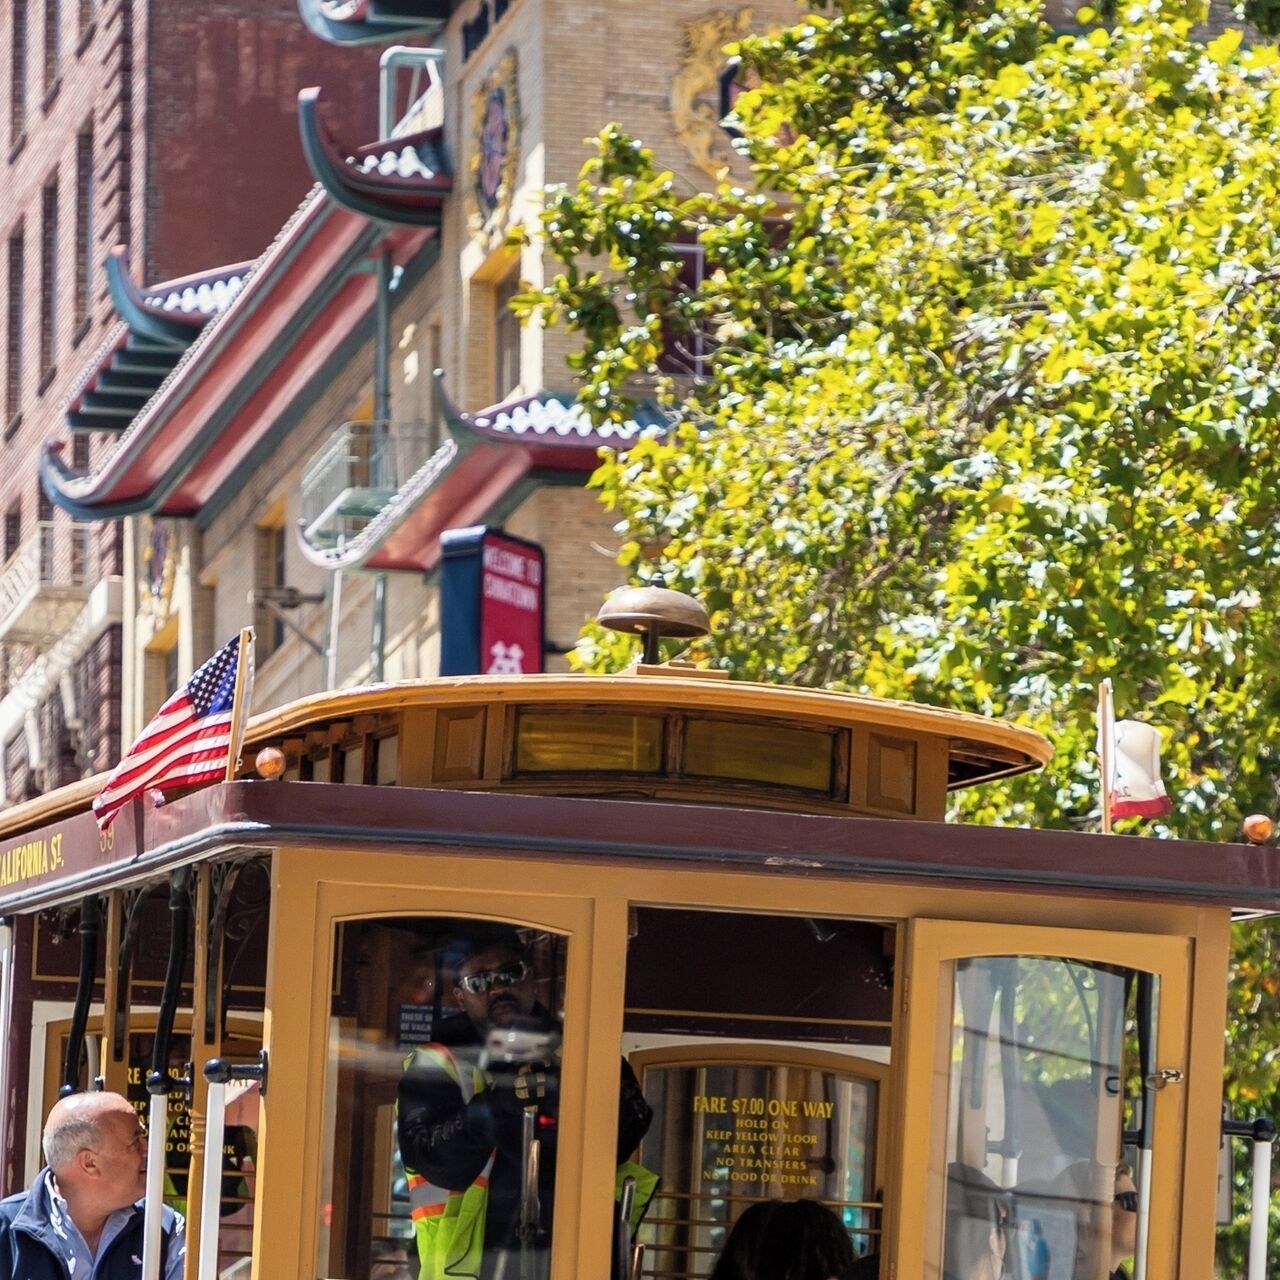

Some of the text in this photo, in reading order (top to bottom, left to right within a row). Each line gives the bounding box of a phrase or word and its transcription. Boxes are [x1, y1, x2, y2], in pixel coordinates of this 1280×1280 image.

[693, 1096, 834, 1119] FARE $7.00 ONE WAY
[735, 1119, 790, 1130] HOLD ON
[705, 1130, 818, 1144] KEEP YELLOW FLOOR
[723, 1144, 800, 1157] AREA CLEAR
[716, 1157, 807, 1170] NO TRANSFERS
[703, 1170, 817, 1185] NO FOOD OR DRINK
